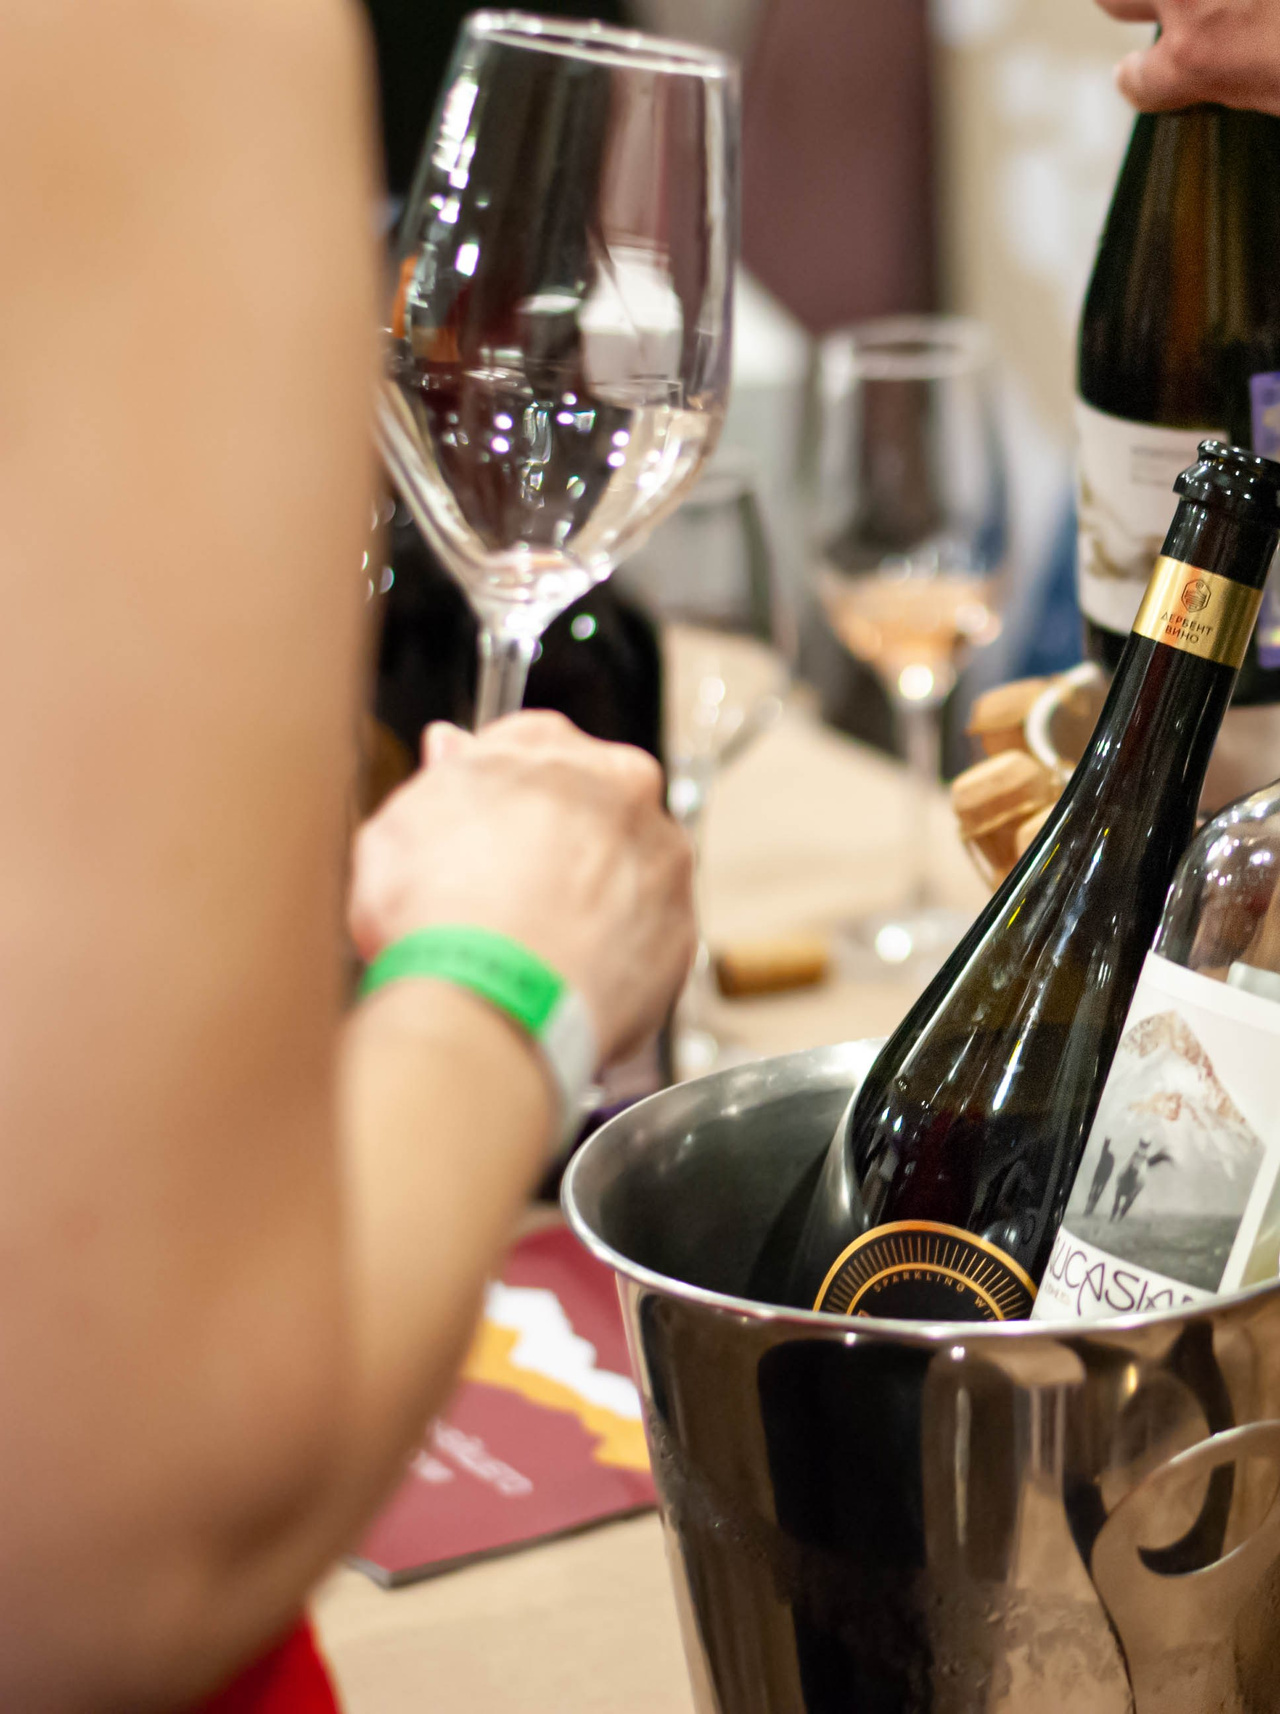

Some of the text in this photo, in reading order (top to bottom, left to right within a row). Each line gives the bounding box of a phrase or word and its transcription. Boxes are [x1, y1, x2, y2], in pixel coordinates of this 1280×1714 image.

[1161, 611, 1213, 636] ДЕРБЕНТ
[1165, 624, 1200, 644] ВИНО
[873, 1269, 966, 1293] SPARKLING
[1050, 1237, 1194, 1317] UCASIA
